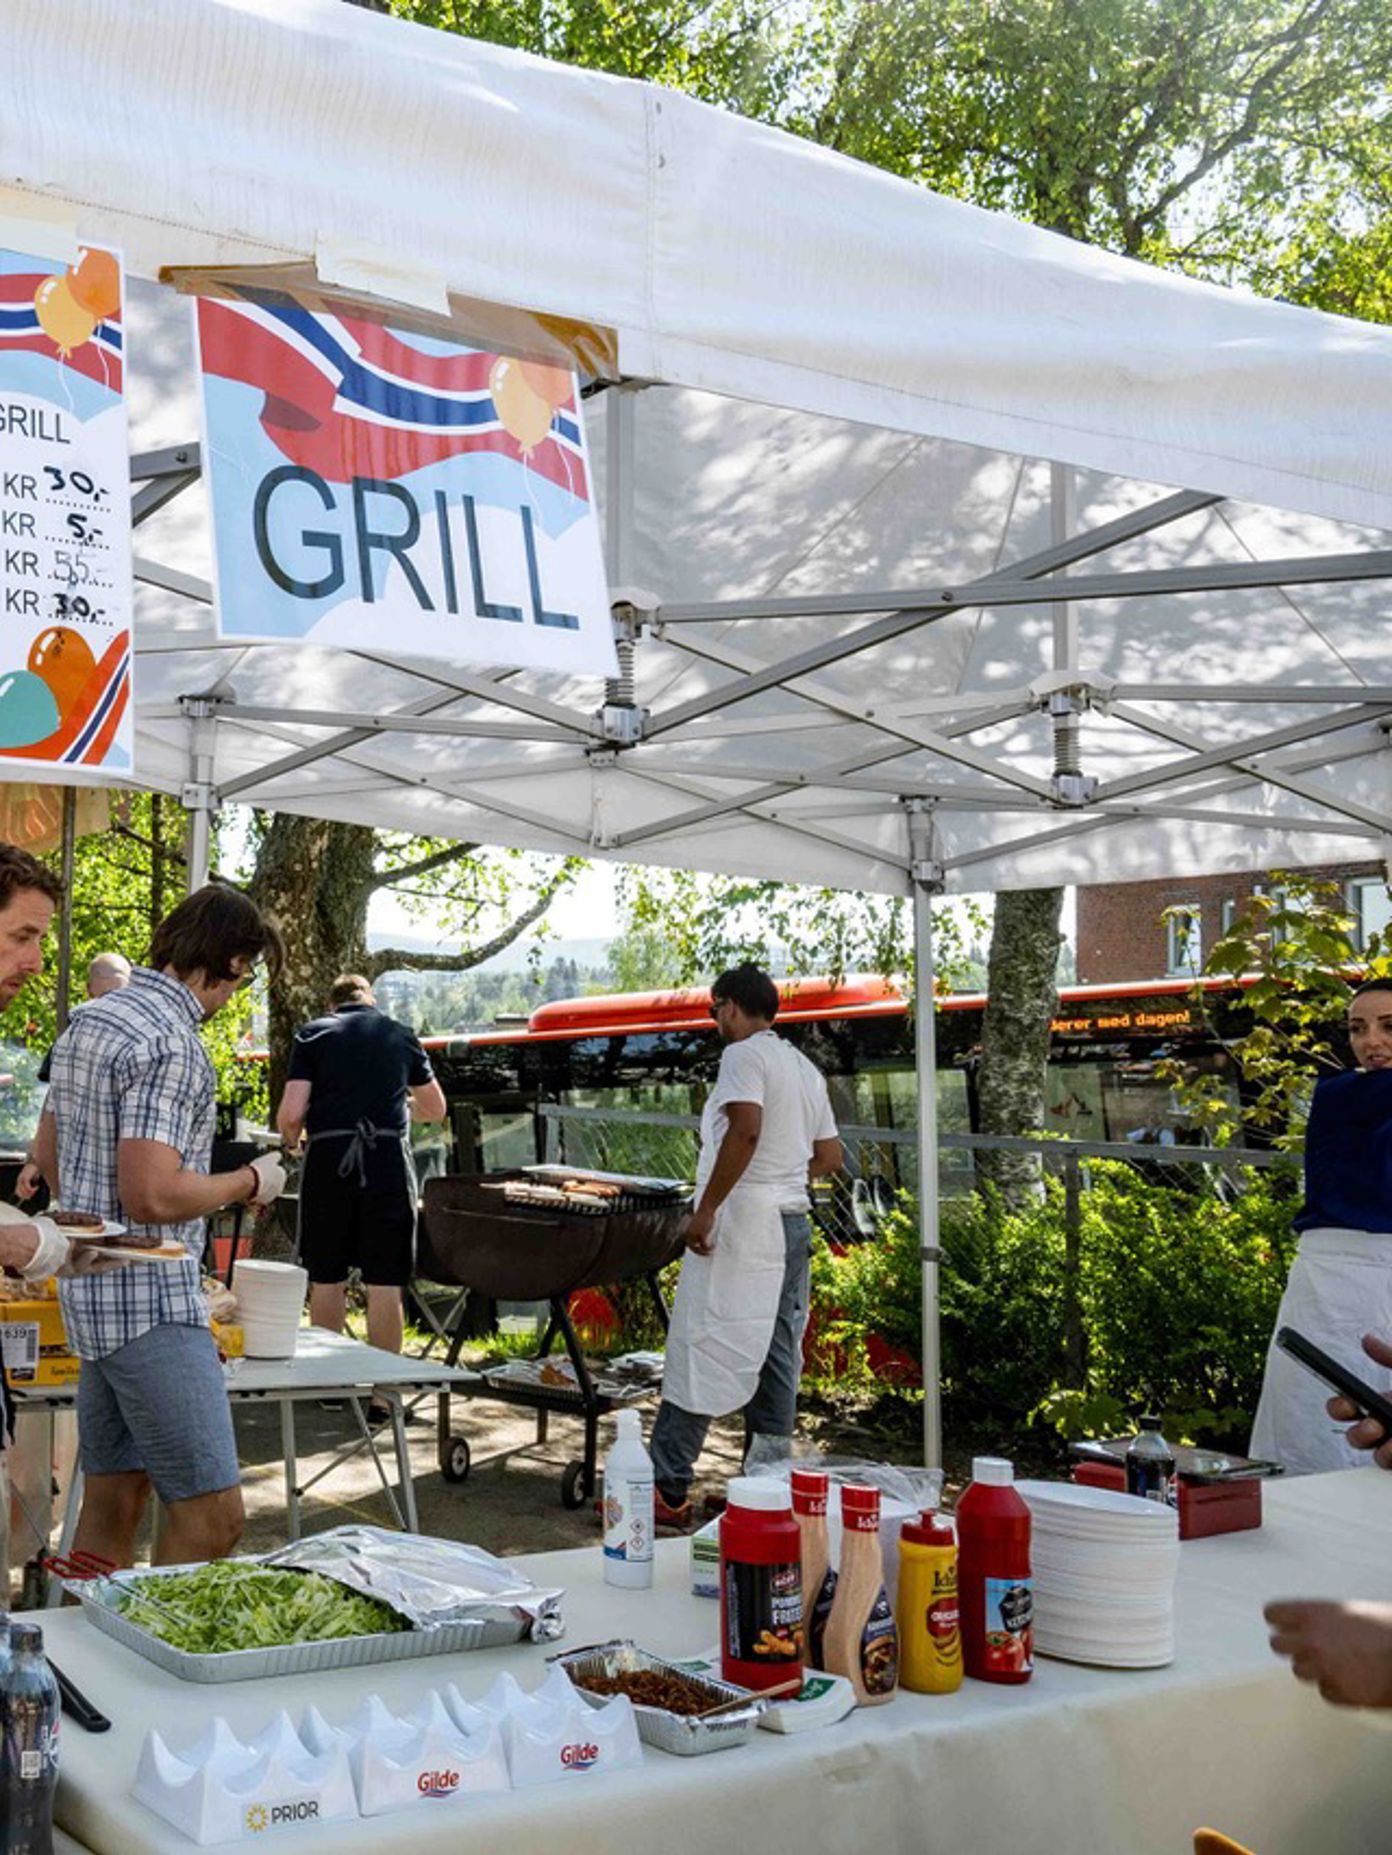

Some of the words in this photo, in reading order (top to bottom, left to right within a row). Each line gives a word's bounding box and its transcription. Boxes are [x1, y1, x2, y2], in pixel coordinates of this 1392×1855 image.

[3, 472, 38, 501] KR
[2, 510, 36, 539] KR
[253, 464, 580, 630] GRILL
[5, 549, 39, 578] KR
[5, 587, 40, 616] KR
[1097, 1014, 1131, 1029] med
[560, 1742, 600, 1764] Gilde
[417, 1769, 460, 1792] Gilde
[271, 1800, 319, 1824] PRIOR
